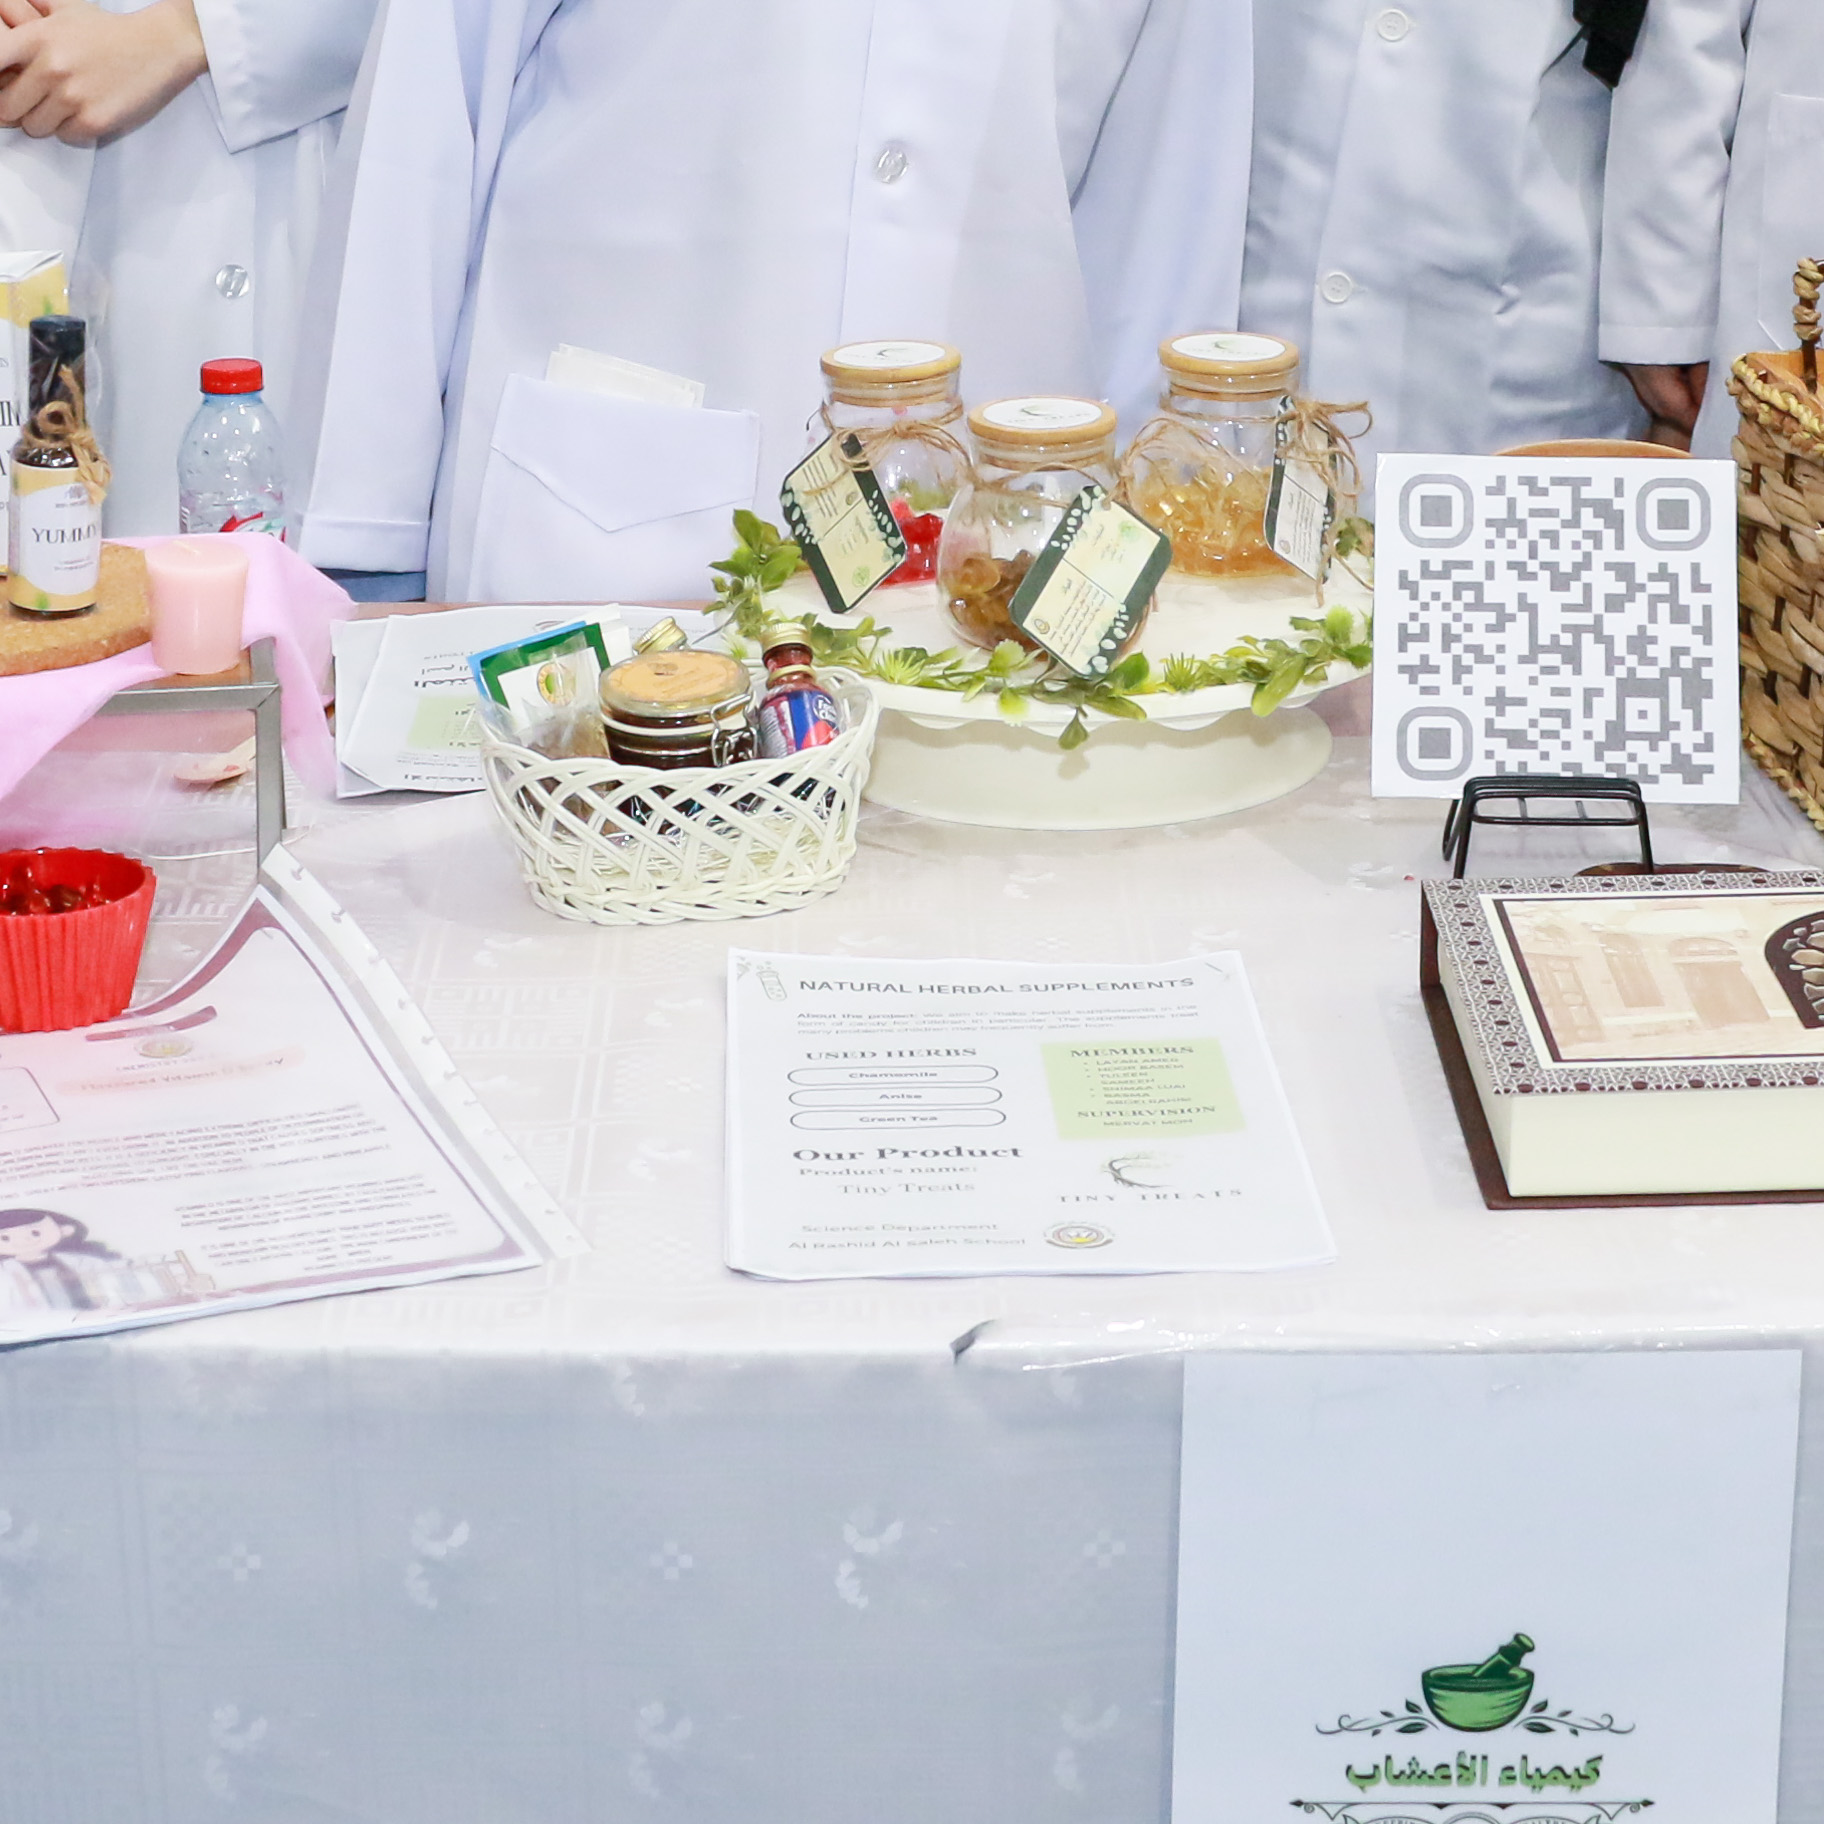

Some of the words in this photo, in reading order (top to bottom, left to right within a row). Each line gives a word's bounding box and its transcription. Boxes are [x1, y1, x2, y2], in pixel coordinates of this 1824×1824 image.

[413, 675, 477, 689] المنت
[797, 979, 913, 995] NATURAL
[917, 984, 1014, 995] HERBAL
[1018, 976, 1196, 994] SUPPLEMENTS
[804, 1049, 879, 1062] USED
[884, 1046, 979, 1059] HERBS
[1069, 1045, 1196, 1058] MEMBERS
[847, 1070, 940, 1080] Chamomile
[877, 1092, 924, 1101] Anise
[858, 1115, 907, 1124] Green
[910, 1114, 940, 1123] Tea
[1077, 1105, 1217, 1119] SUPERVISION
[791, 1146, 866, 1163] Our
[875, 1143, 1026, 1162] Product
[798, 1165, 904, 1178] Product's
[908, 1164, 979, 1176] name:
[836, 1181, 893, 1198] Tiny
[896, 1180, 976, 1194] Treats
[1058, 1194, 1117, 1204] TINY
[800, 1223, 877, 1233] Science
[880, 1222, 1000, 1234] Department
[812, 1238, 877, 1250] Rashid
[881, 1238, 901, 1249] Al
[962, 1235, 1027, 1247] School
[1344, 1749, 1489, 1795] الأعشاب
[1497, 1753, 1606, 1795] كيمياء
